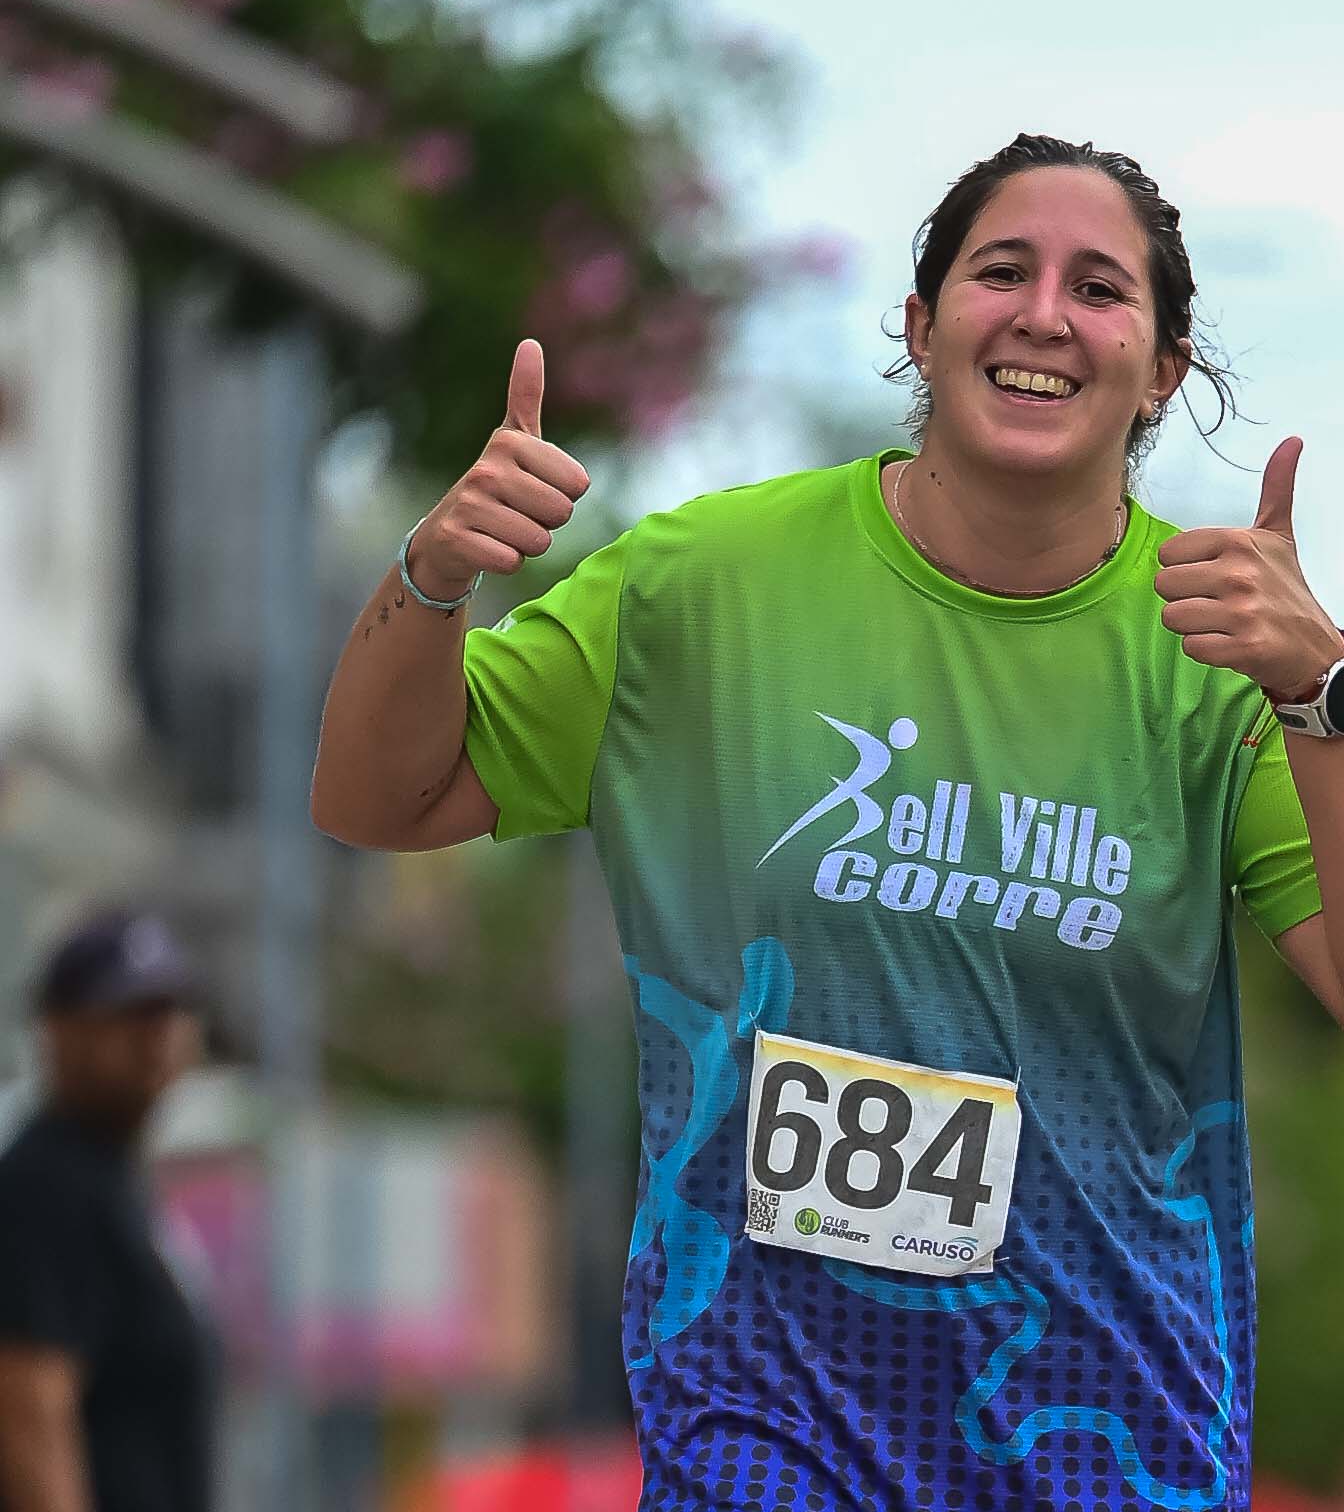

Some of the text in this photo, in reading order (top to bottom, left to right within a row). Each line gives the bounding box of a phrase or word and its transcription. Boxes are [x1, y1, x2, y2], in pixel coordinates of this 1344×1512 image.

[1000, 791, 1132, 896] Ville
[813, 850, 1123, 951] corre
[752, 1060, 994, 1228] 684
[822, 1215, 850, 1229] CLUB
[891, 1234, 975, 1262] CARUSO
